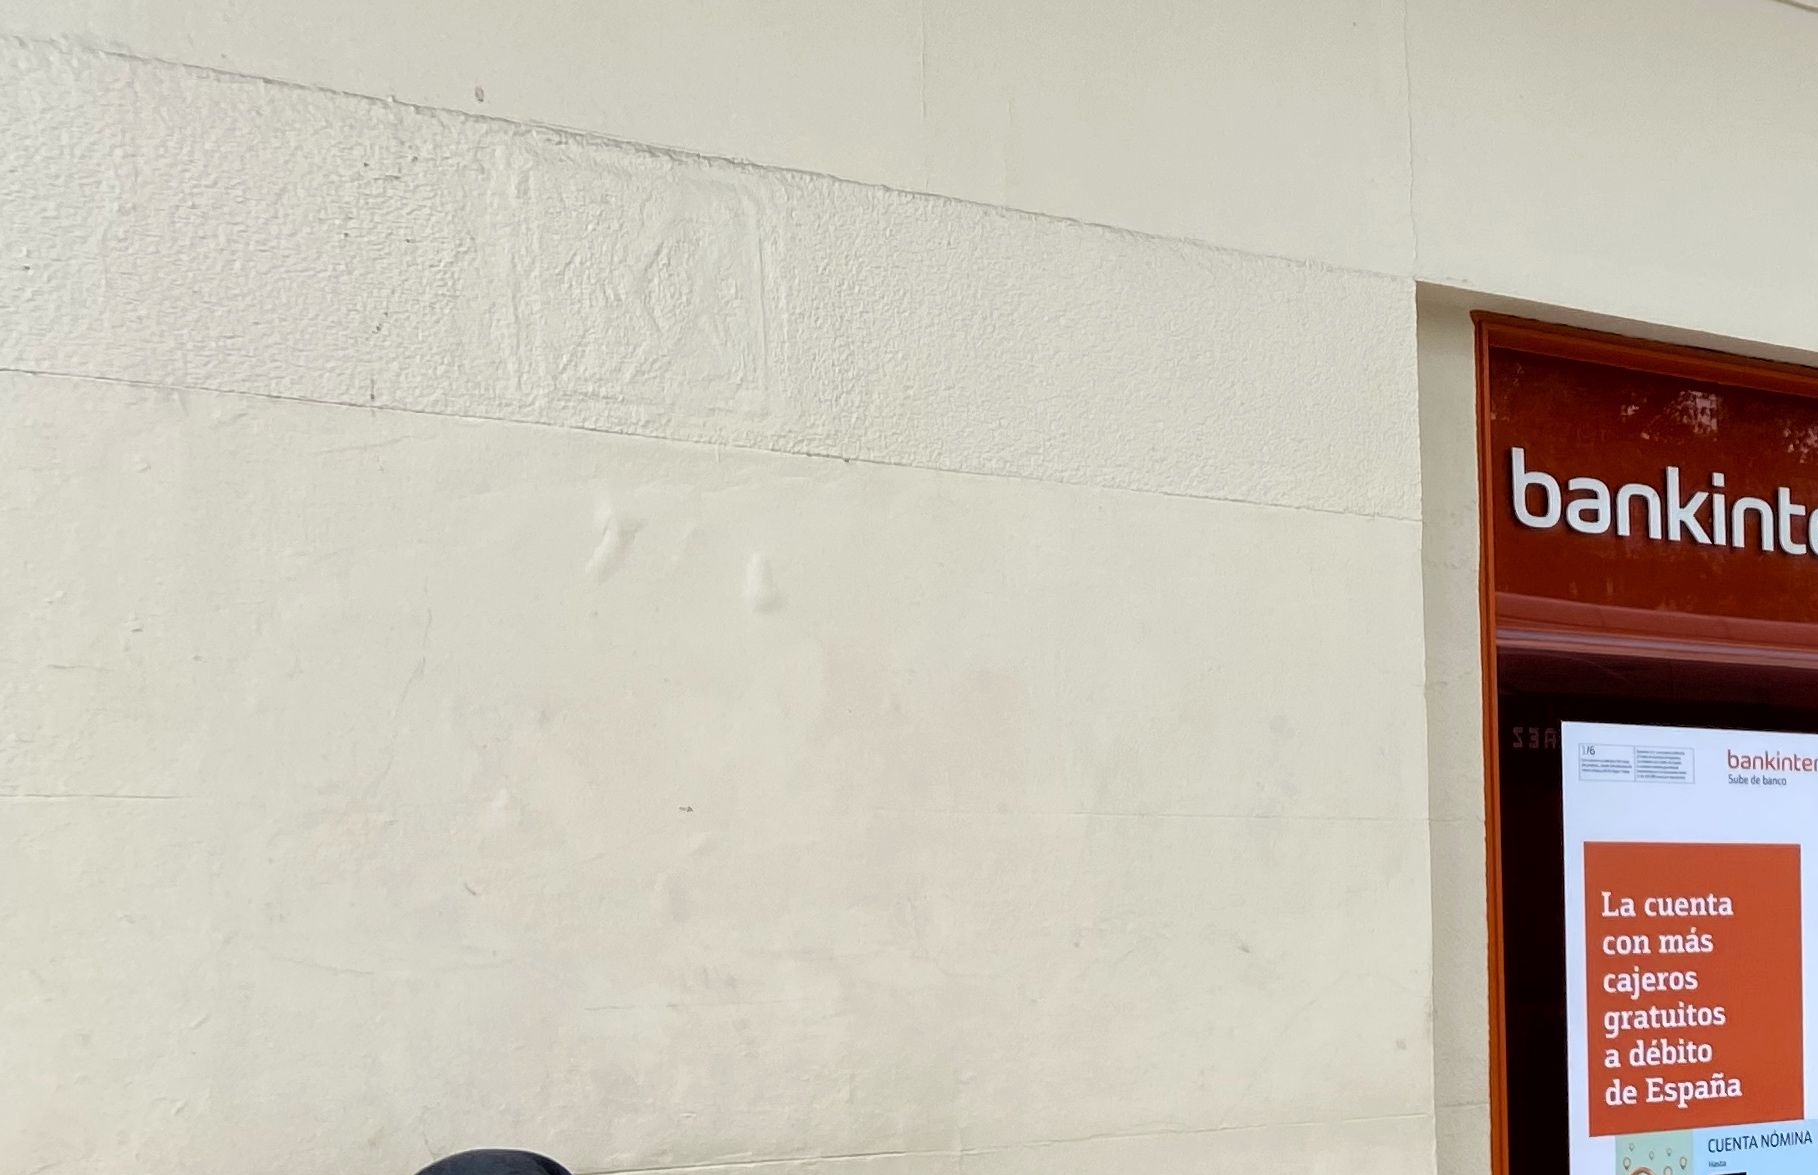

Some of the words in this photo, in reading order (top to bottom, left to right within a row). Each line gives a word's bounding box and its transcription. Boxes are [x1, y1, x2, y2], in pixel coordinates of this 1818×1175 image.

[1728, 774, 1749, 785] Sube
[1750, 775, 1761, 785] de
[1762, 775, 1787, 786] banco
[1601, 890, 1636, 918] La
[1644, 893, 1734, 918] cuenta
[1602, 933, 1651, 956] con
[1658, 926, 1714, 954] más
[1602, 965, 1699, 1001] cajeros
[1603, 1000, 1727, 1039] gratuitos
[1604, 1048, 1621, 1068] a
[1628, 1038, 1714, 1067] débito
[1605, 1078, 1638, 1106] de
[1645, 1072, 1743, 1109] España
[1708, 1135, 1759, 1154] CUENTA
[1761, 1130, 1813, 1149] NÓMINA
